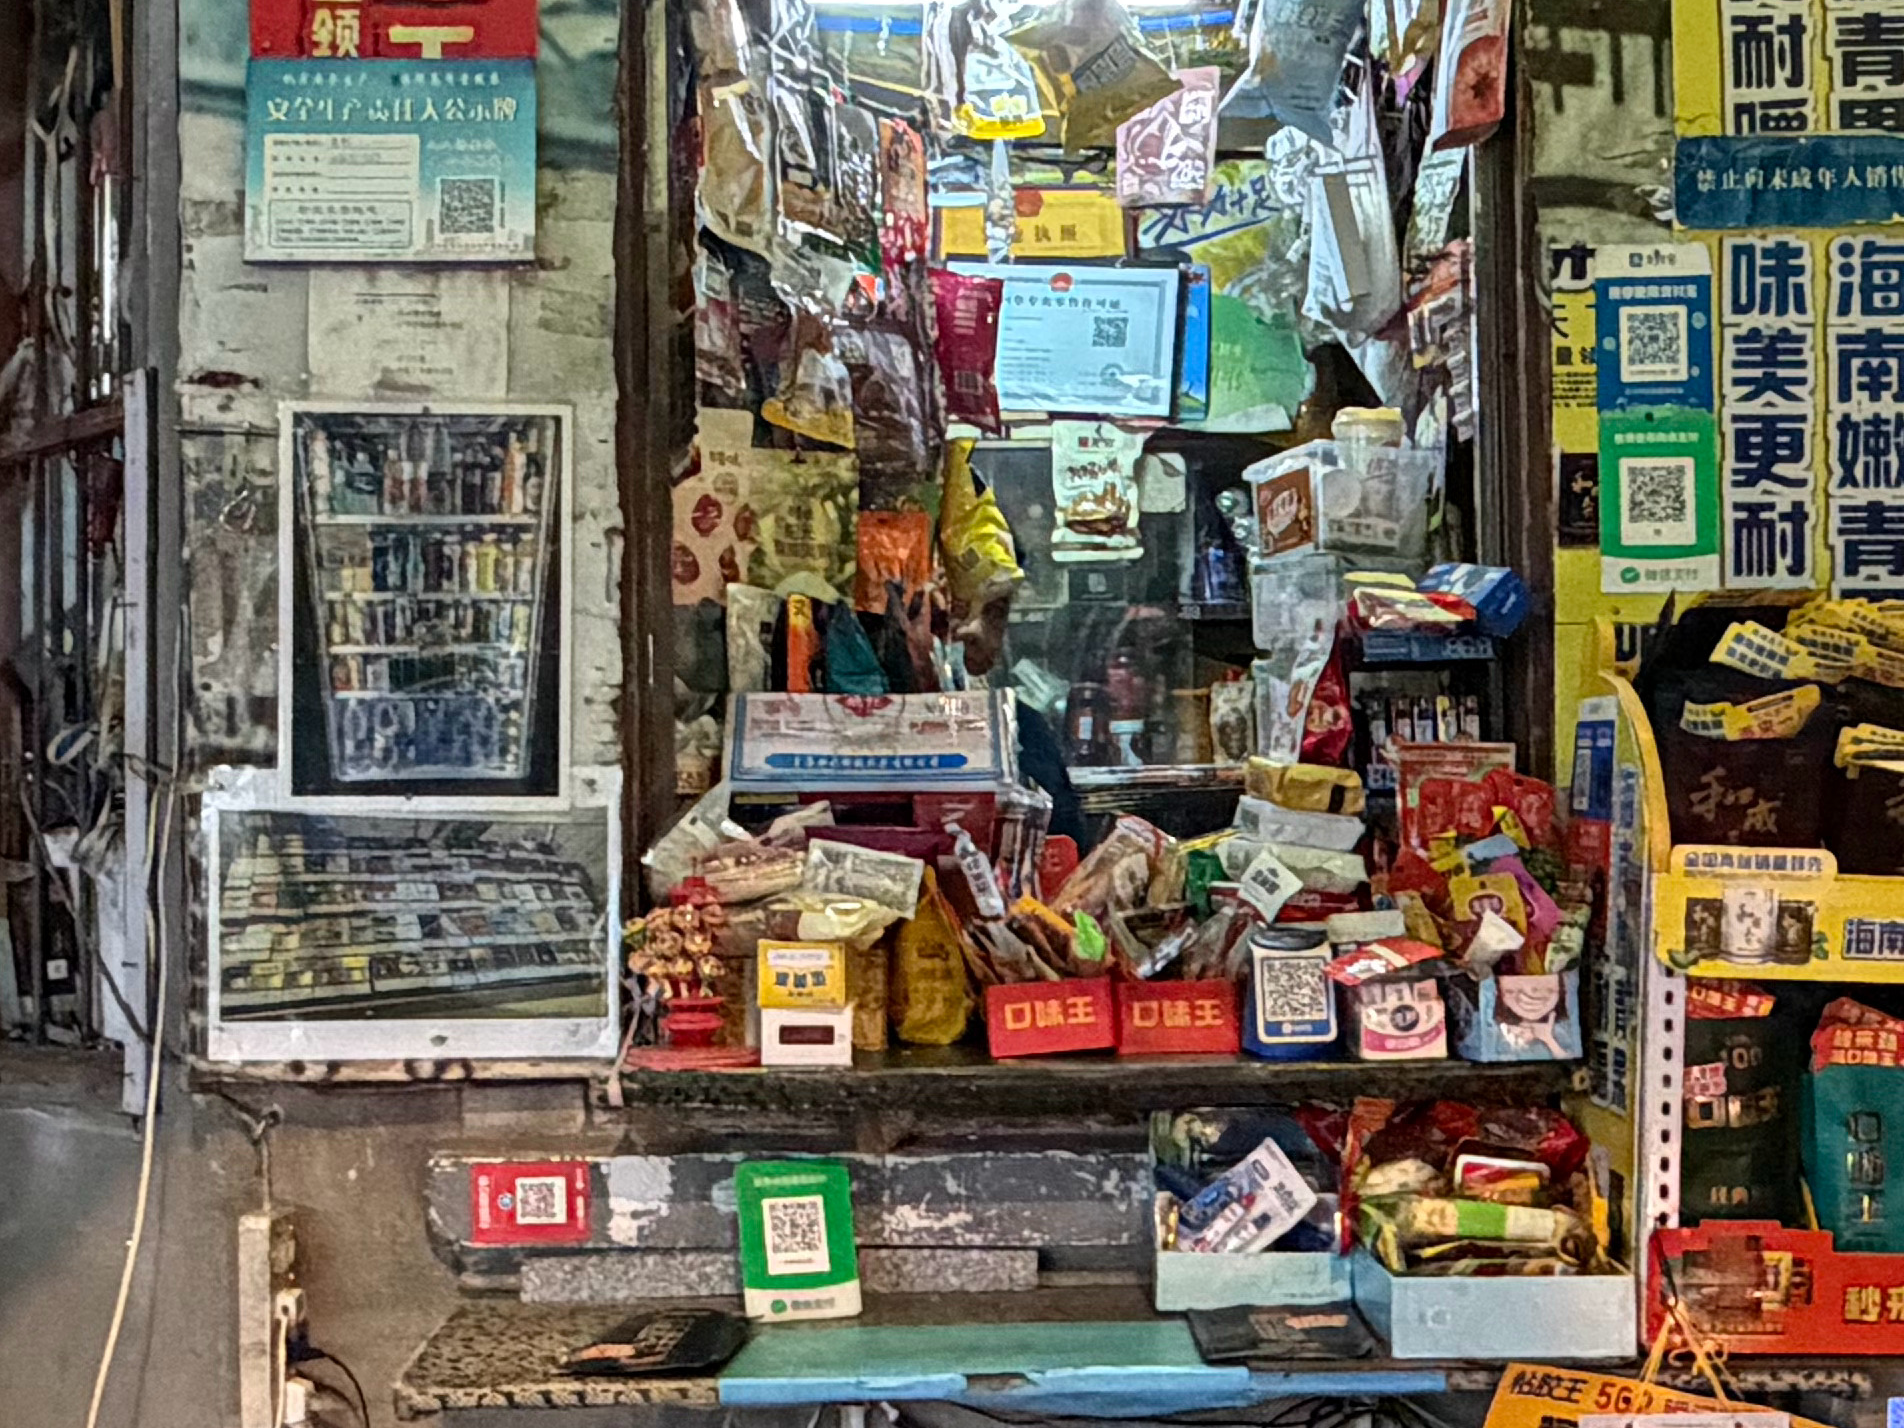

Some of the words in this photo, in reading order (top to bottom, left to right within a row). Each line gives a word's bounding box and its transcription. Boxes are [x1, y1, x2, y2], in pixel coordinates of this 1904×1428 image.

[1729, 240, 1809, 581] 味美更耐
[1003, 995, 1097, 1031] 口味王
[1132, 998, 1225, 1030] 口味王
